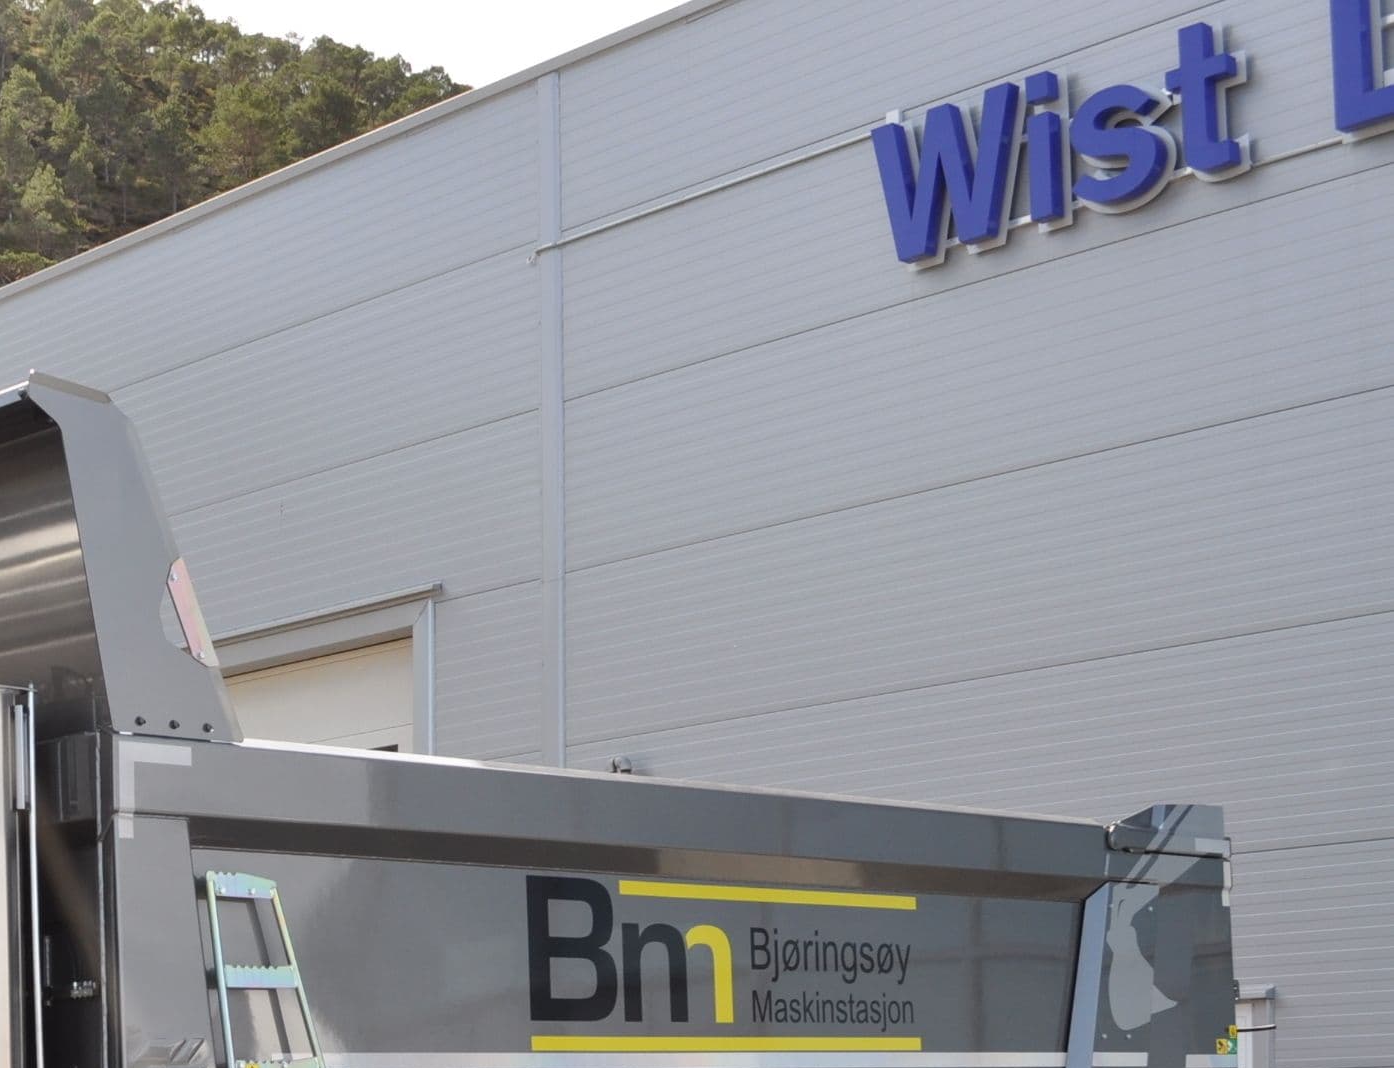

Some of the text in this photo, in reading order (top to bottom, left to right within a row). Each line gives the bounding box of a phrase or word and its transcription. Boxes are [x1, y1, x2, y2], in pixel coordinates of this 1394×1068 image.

[871, 21, 1246, 268] Wist
[749, 926, 911, 985] Bjøringsøy
[751, 990, 915, 1032] Maskinstasjon
